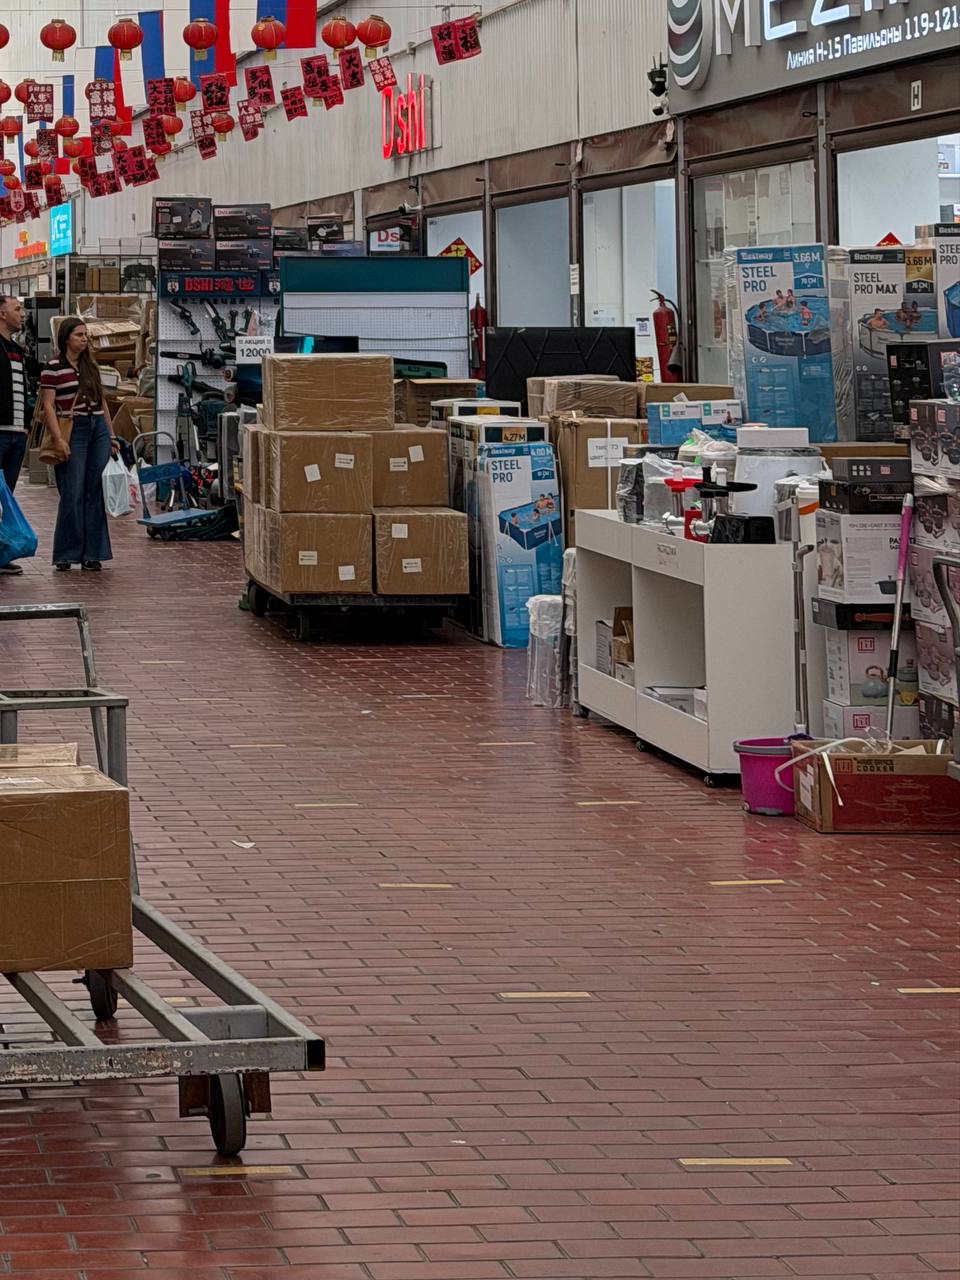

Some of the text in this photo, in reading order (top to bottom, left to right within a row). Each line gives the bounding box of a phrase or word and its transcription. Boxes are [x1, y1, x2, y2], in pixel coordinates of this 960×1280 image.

[787, 49, 814, 70] Линия
[843, 26, 902, 56] Павильоны
[377, 229, 400, 243] Ds
[939, 244, 960, 254] STEE
[939, 255, 958, 265] PRO
[742, 266, 777, 279] STEEL
[853, 272, 882, 283] STEEL
[743, 280, 768, 293] PRO
[854, 283, 898, 295] PRO MAX
[240, 347, 271, 359] 12000
[491, 459, 522, 471] STEEL
[492, 471, 513, 483] PRO
